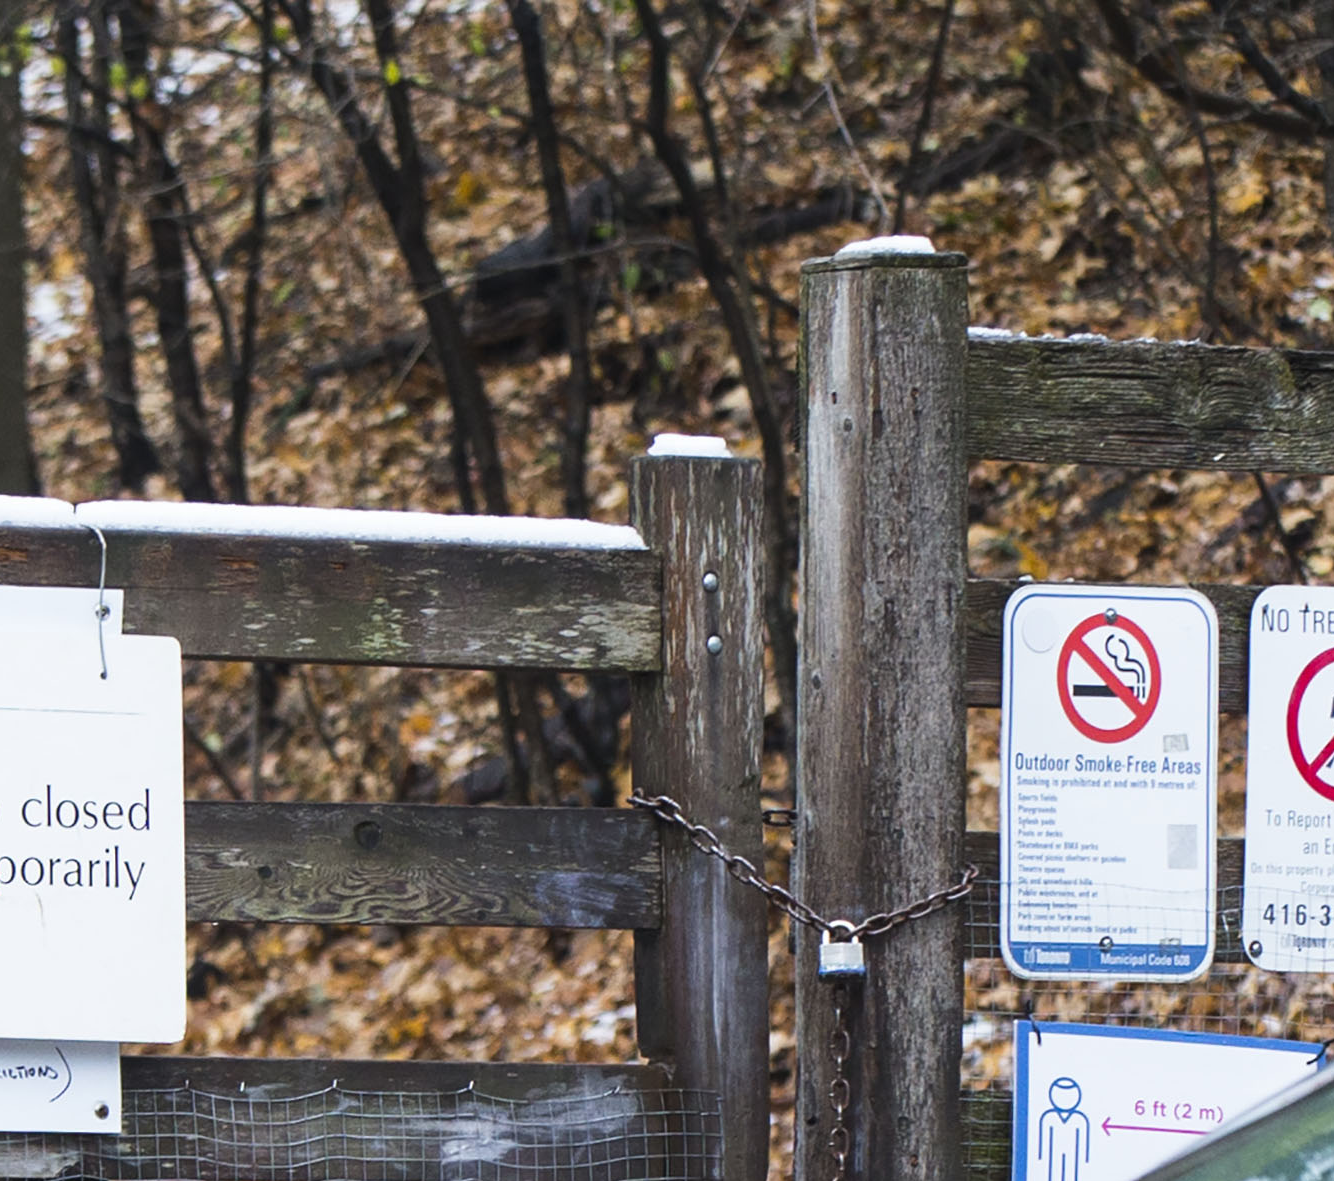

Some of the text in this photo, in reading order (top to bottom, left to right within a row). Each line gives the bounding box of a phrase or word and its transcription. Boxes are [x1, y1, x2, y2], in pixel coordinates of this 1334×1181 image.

[1261, 606, 1290, 632] NO
[1015, 752, 1202, 775] Outdoor Smoke-Free Areas
[1017, 775, 1050, 788] Smoking
[1061, 778, 1101, 788] prohibited
[1114, 779, 1127, 788] and
[21, 784, 151, 831] closed
[1266, 809, 1282, 827] To
[1286, 810, 1332, 831] Report
[1302, 841, 1319, 855] an
[1285, 864, 1324, 878] property
[1100, 952, 1147, 966] Municipal
[1148, 952, 1172, 967] Code
[1134, 1099, 1224, 1124] 6 ft (2 m)
